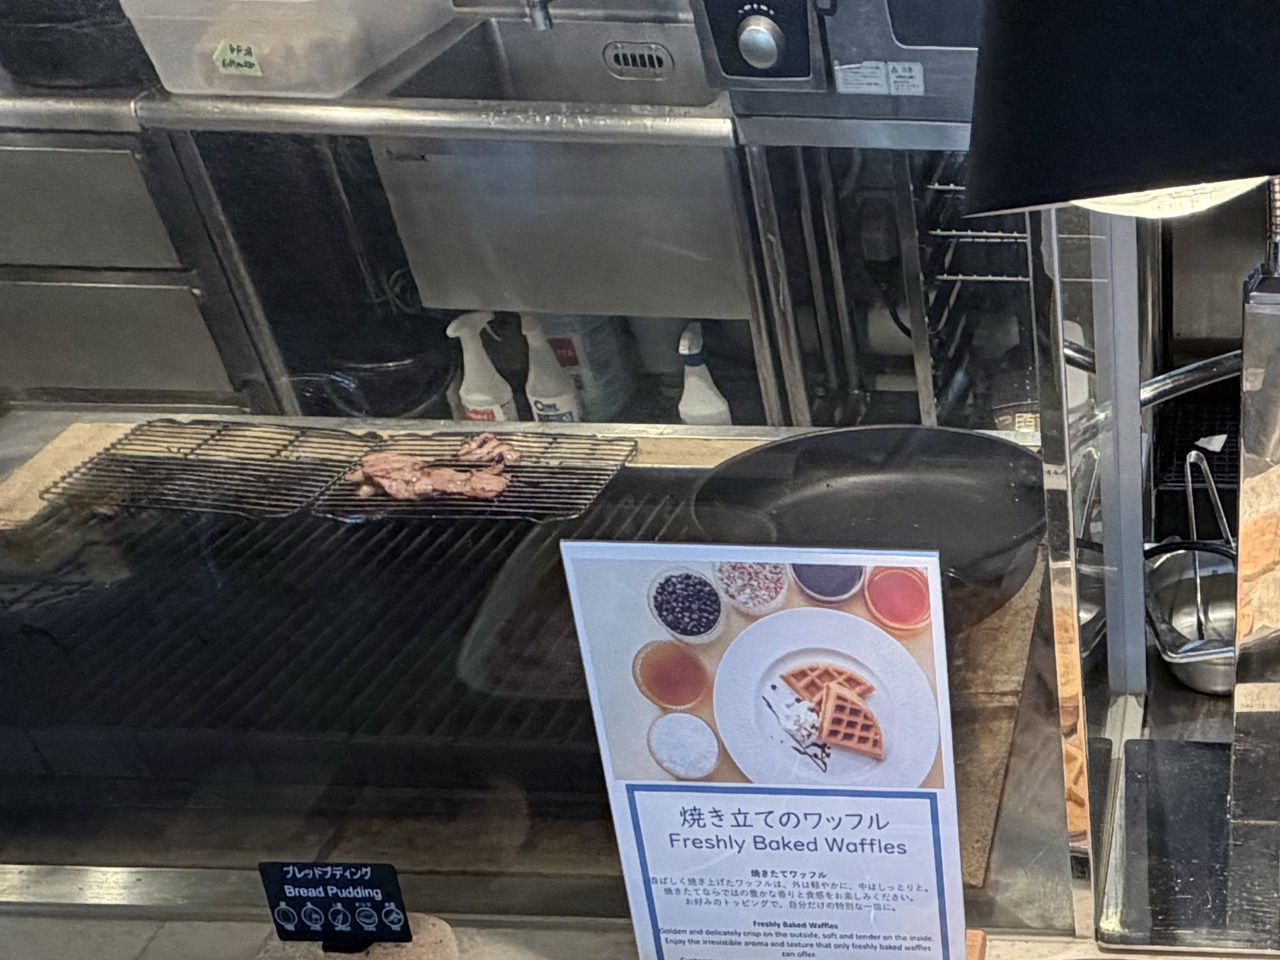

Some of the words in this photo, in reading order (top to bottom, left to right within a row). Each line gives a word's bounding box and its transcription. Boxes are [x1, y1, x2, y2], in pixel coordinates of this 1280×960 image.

[680, 805, 890, 831] 焼き立てのワッフル
[669, 833, 746, 854] Freshly
[753, 835, 818, 852] Baked
[825, 837, 907, 855] Waffles
[751, 869, 827, 879] 焼きたてワッフル
[284, 885, 324, 897] Bread
[327, 886, 382, 901] Pudding
[753, 920, 780, 929] Freshly
[809, 922, 838, 930] Waffles
[705, 929, 741, 937] delicately
[743, 930, 761, 938] crisp
[789, 931, 820, 939] outside,
[665, 937, 686, 946] Enjoy
[702, 939, 741, 947] irresistible
[770, 940, 784, 948] and
[816, 941, 831, 949] that
[833, 942, 850, 950] only
[852, 943, 877, 951] freshly
[879, 943, 902, 951] baked
[904, 944, 931, 952] waffles
